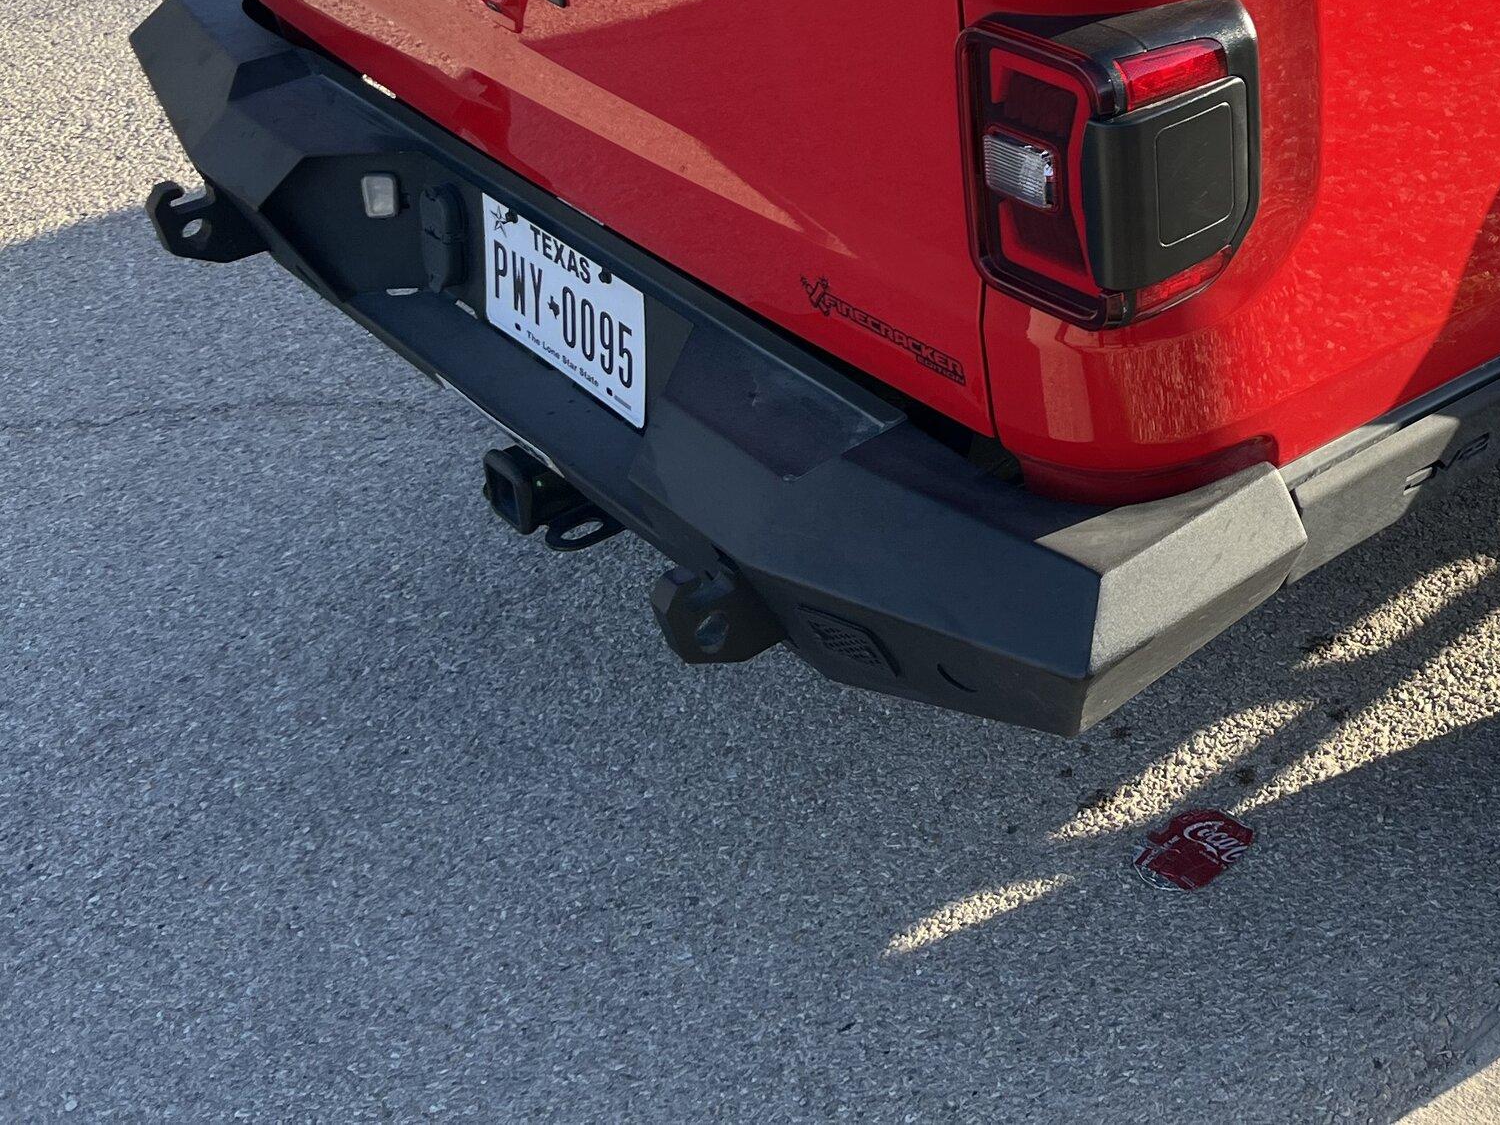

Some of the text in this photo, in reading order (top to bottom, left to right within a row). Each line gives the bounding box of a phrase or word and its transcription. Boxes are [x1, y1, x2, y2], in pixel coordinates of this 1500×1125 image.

[529, 224, 591, 285] TEXAS
[494, 239, 633, 389] PWY 0095
[526, 330, 600, 387] The Lone Star State
